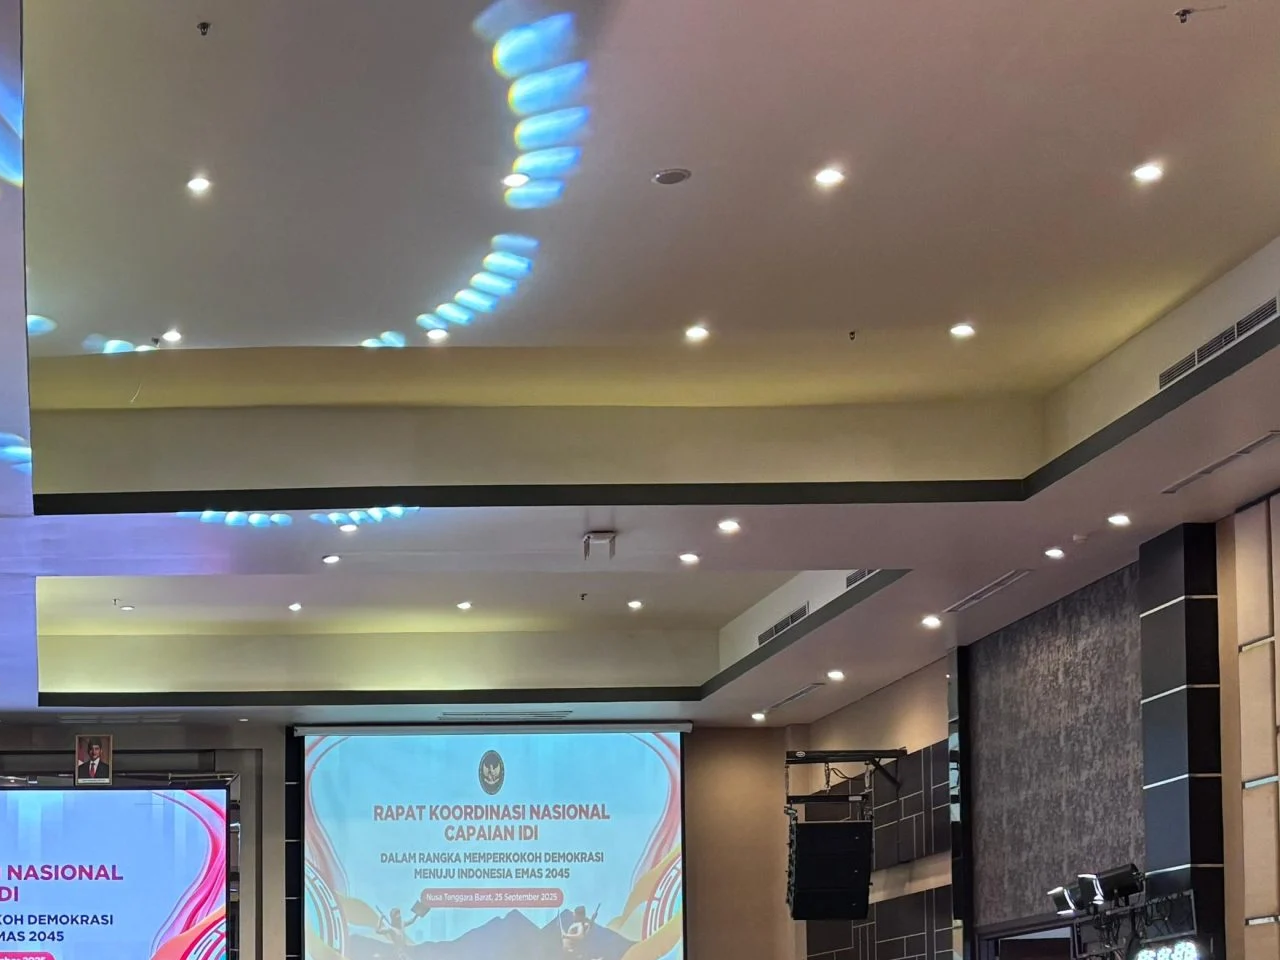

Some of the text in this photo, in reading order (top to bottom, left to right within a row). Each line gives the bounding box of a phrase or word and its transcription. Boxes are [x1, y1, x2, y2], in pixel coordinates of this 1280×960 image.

[373, 804, 610, 821] RAPAT KOORDINASI NASIONAL
[444, 825, 538, 841] CAPAIAN IDI
[380, 852, 604, 863] DALAM RANGKA MEMPERKOKOH DEMOKRASI
[7, 864, 124, 881] NASIONAL
[414, 868, 570, 879] MENUJU INDONESIA EMAS 2045
[426, 893, 443, 902] Nusa
[444, 893, 473, 902] Tenggara
[504, 893, 539, 902] September
[28, 914, 113, 925] DEMOKRASI
[29, 931, 64, 942] 2045
